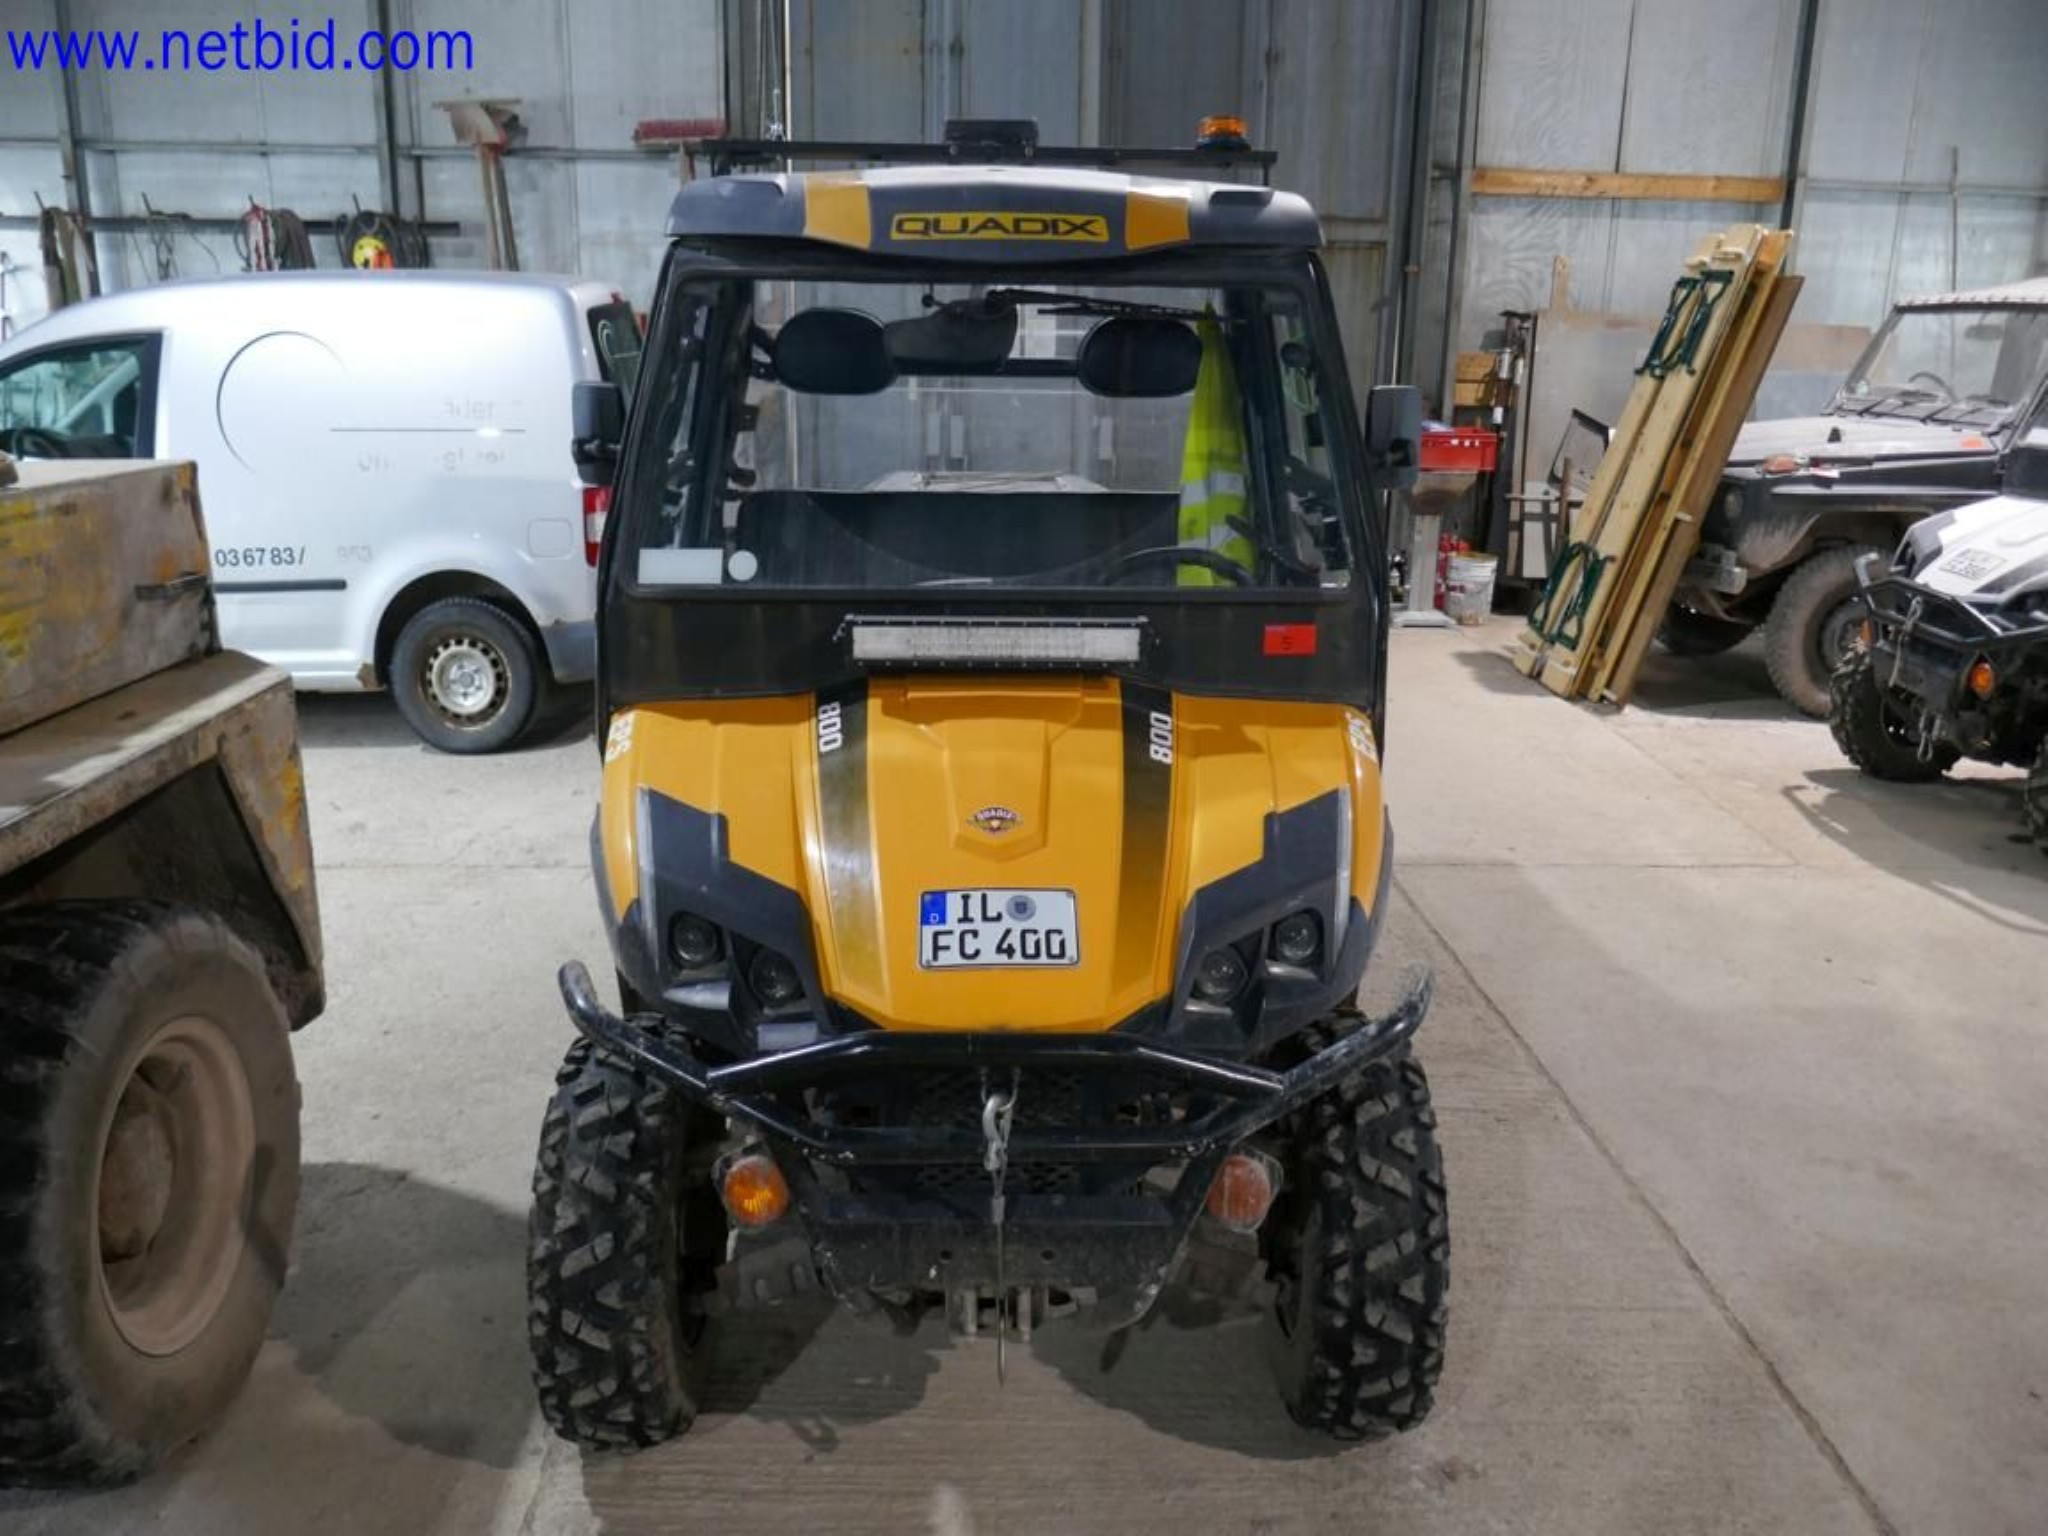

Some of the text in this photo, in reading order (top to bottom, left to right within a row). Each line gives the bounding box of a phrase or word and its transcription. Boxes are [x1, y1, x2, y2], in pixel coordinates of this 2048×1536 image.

[894, 216, 1103, 237] QUADIX
[818, 701, 842, 754] 800
[1149, 711, 1173, 765] 800
[957, 893, 1003, 924] IL
[932, 928, 1066, 962] FC 400
